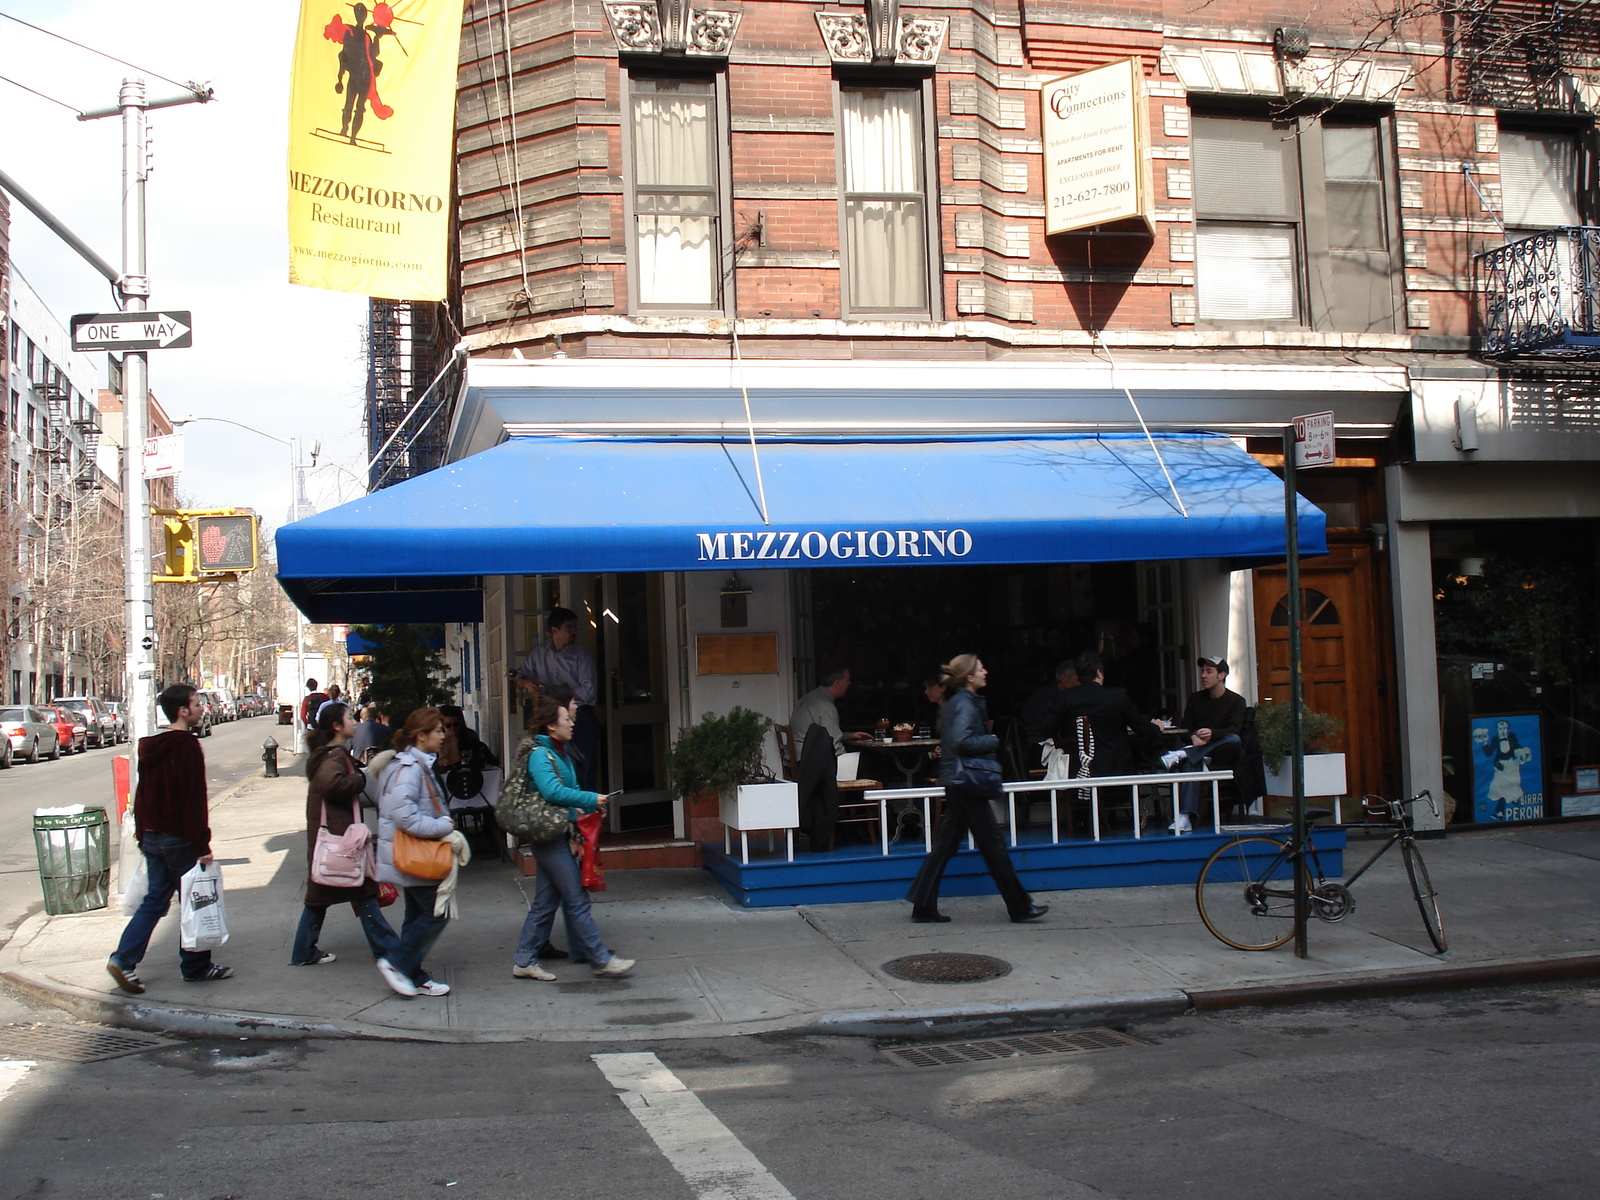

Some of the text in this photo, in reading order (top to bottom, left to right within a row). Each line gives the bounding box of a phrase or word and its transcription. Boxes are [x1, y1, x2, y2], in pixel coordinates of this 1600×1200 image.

[1050, 84, 1081, 114] City
[1056, 89, 1126, 119] Connections
[1055, 138, 1070, 147] Better
[1070, 133, 1082, 142] Real
[1083, 130, 1099, 140] Estate
[1056, 144, 1124, 166] APARTMENTS FOR RENT
[1059, 163, 1121, 185] EXCLUSIVE BROKER
[289, 169, 442, 213] MEZZOGIORNO
[1053, 180, 1130, 208] 212-627-7800
[310, 202, 402, 235] Restaurant
[87, 323, 177, 340] ONE WAY
[1293, 416, 1330, 439] NO PARKING
[146, 440, 158, 455] NO
[696, 529, 973, 561] MEZZOGIORNO
[1520, 792, 1543, 806] BIRRA
[1505, 805, 1544, 821] PERONI
